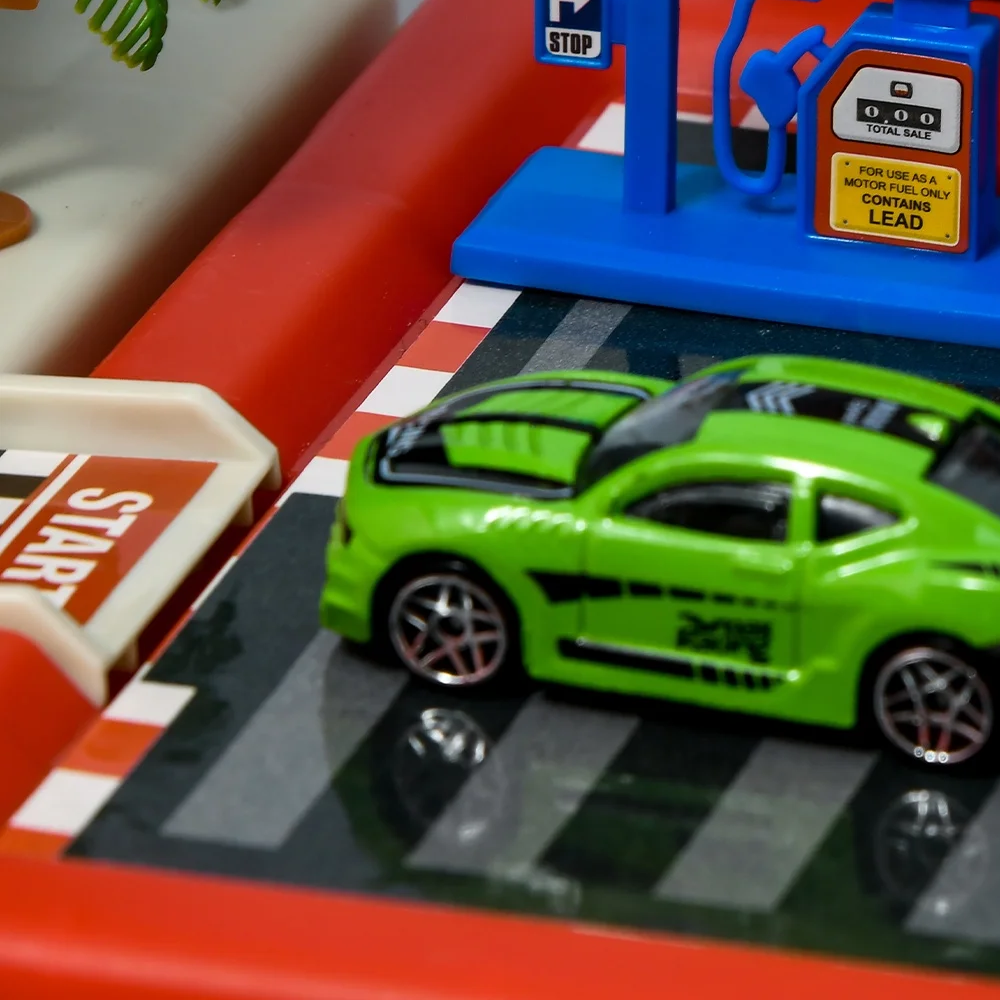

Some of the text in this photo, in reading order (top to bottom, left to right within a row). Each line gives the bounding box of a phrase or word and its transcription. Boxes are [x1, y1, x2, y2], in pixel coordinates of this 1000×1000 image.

[549, 31, 592, 55] STOP
[866, 123, 932, 140] TOTAL SALE
[859, 166, 937, 185] FOR USE AS A
[844, 178, 950, 200] MOTOR FUEL ONLY
[861, 193, 931, 213] CONTAINS
[869, 209, 923, 231] LEAD
